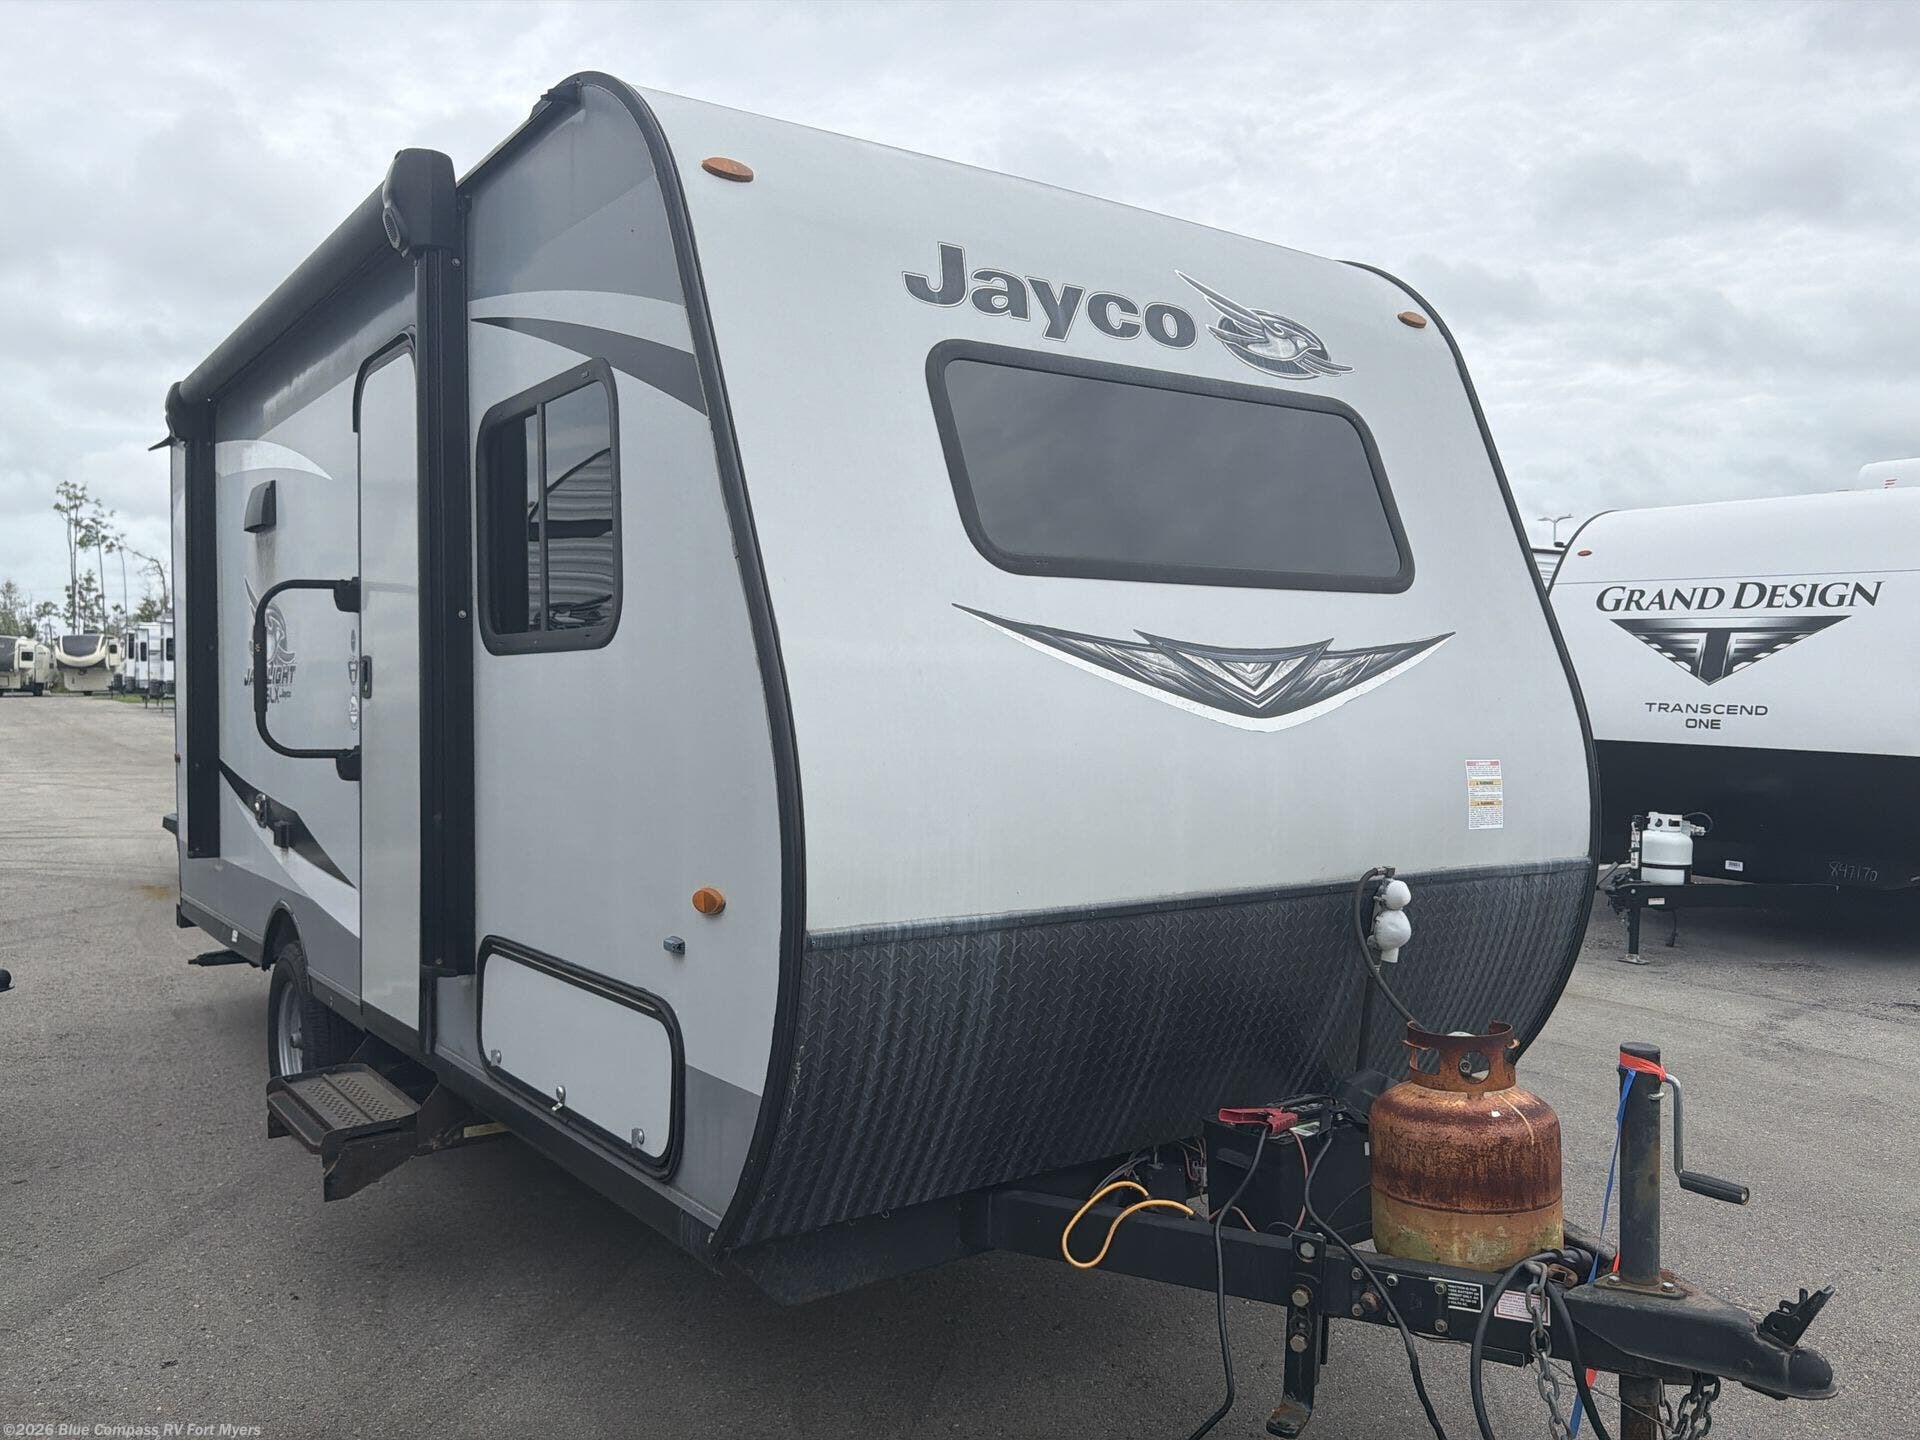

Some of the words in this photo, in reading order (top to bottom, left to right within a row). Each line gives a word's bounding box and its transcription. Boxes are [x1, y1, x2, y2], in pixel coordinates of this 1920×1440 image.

[902, 241, 1198, 350] Jayco
[1596, 586, 1726, 612] GRAND
[1729, 580, 1886, 609] DESIGN
[1645, 702, 1768, 716] TRANSCEND
[1685, 718, 1721, 729] ONE
